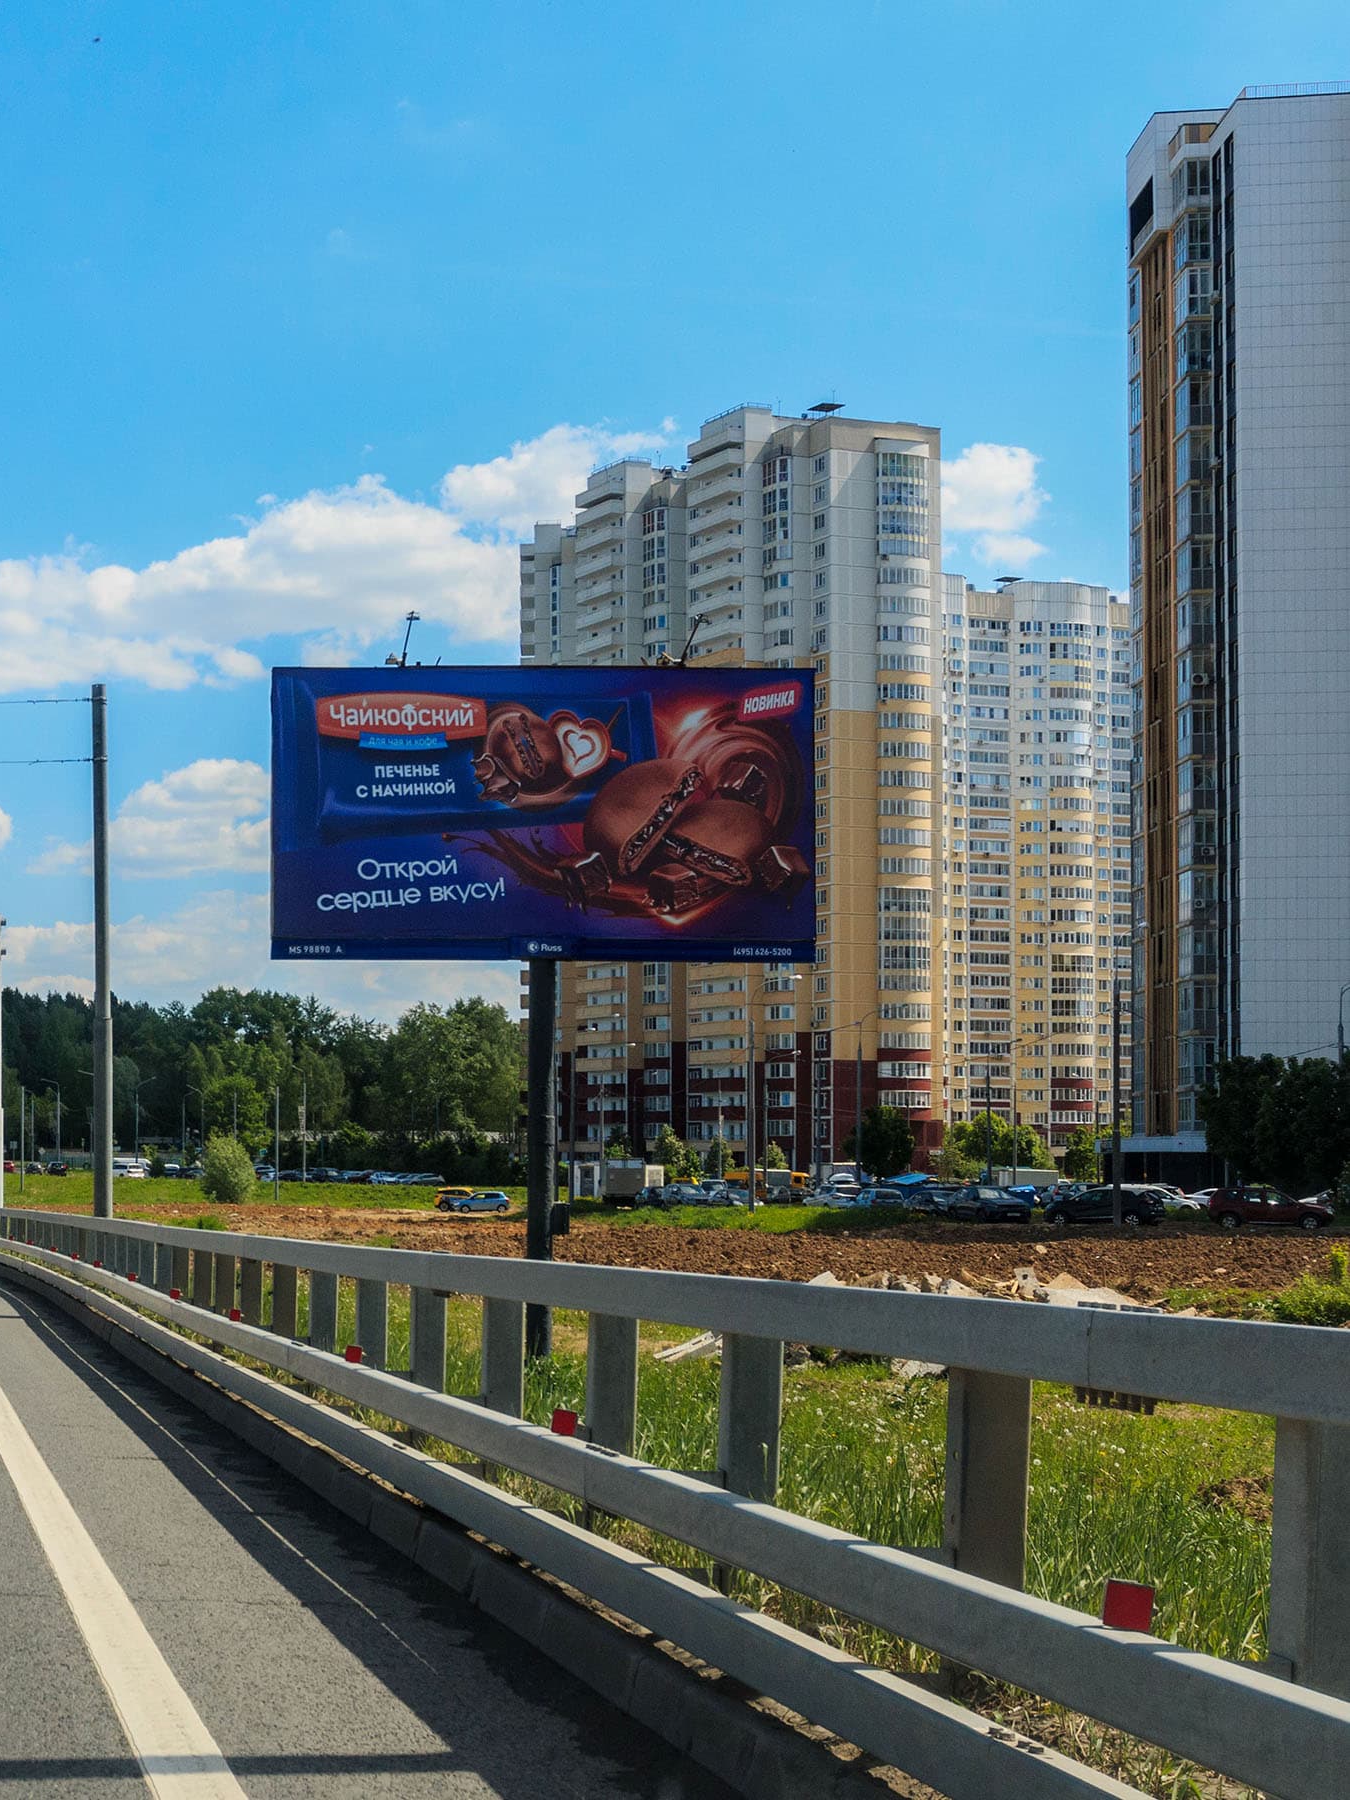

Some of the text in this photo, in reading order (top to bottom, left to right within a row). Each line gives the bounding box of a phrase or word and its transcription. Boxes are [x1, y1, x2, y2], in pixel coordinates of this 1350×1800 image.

[743, 690, 795, 714] НОВИНКА
[329, 700, 474, 731] Чайкофский
[369, 737, 438, 747] для чая и кофе
[374, 764, 441, 778] ПЕЧЕНЬЕ
[356, 779, 456, 798] С НАЧИНКОЙ
[357, 855, 458, 882] Открой
[316, 877, 505, 913] сердце вкусу!
[540, 943, 563, 952] Russ
[755, 947, 792, 956] 626-5200
